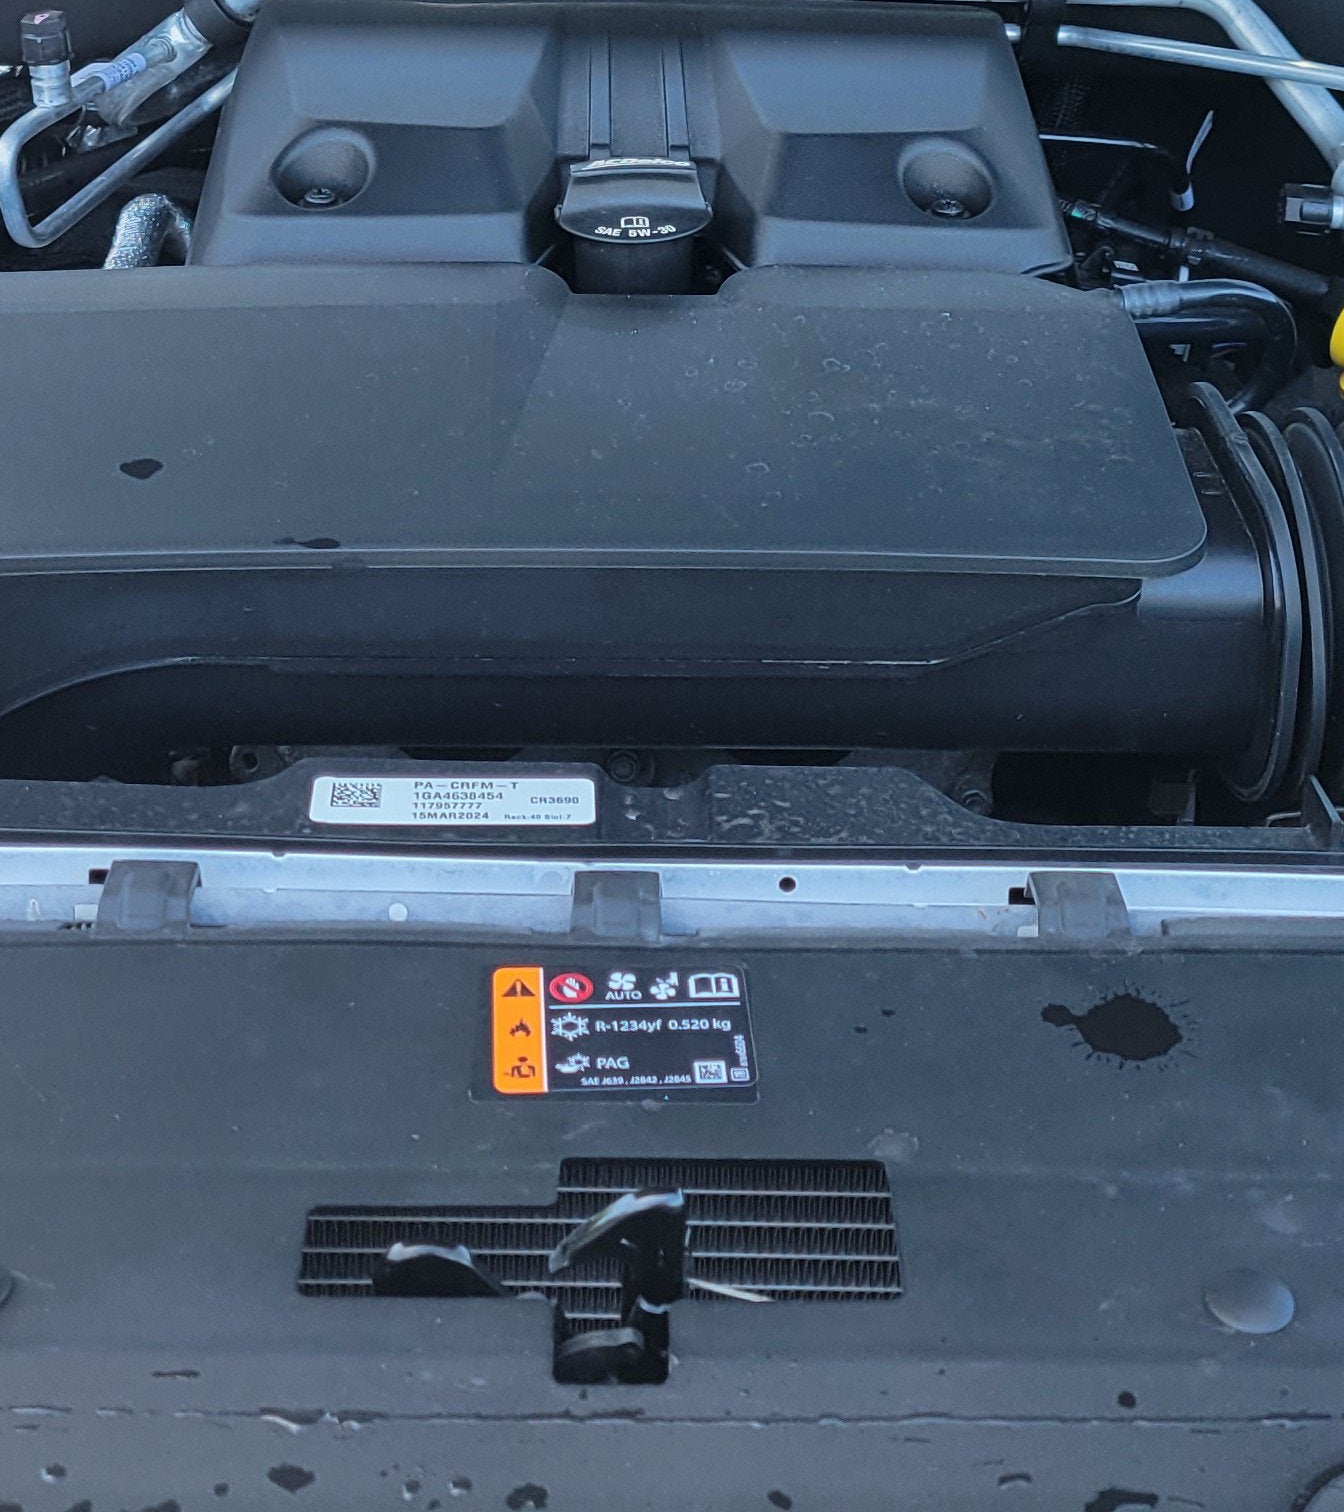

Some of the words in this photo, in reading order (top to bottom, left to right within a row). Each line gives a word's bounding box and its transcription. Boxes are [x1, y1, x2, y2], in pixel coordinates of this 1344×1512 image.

[594, 226, 623, 237] SAE
[628, 224, 677, 237] 5W-30
[530, 796, 580, 804] CR3690
[411, 811, 490, 820] 15MAR2024
[604, 990, 643, 1001] AUTO
[594, 1018, 663, 1033] R-1234yf
[667, 1018, 710, 1031] 0.520
[712, 1017, 732, 1032] kg
[596, 1056, 630, 1070] PAG
[580, 1076, 600, 1086] SAE
